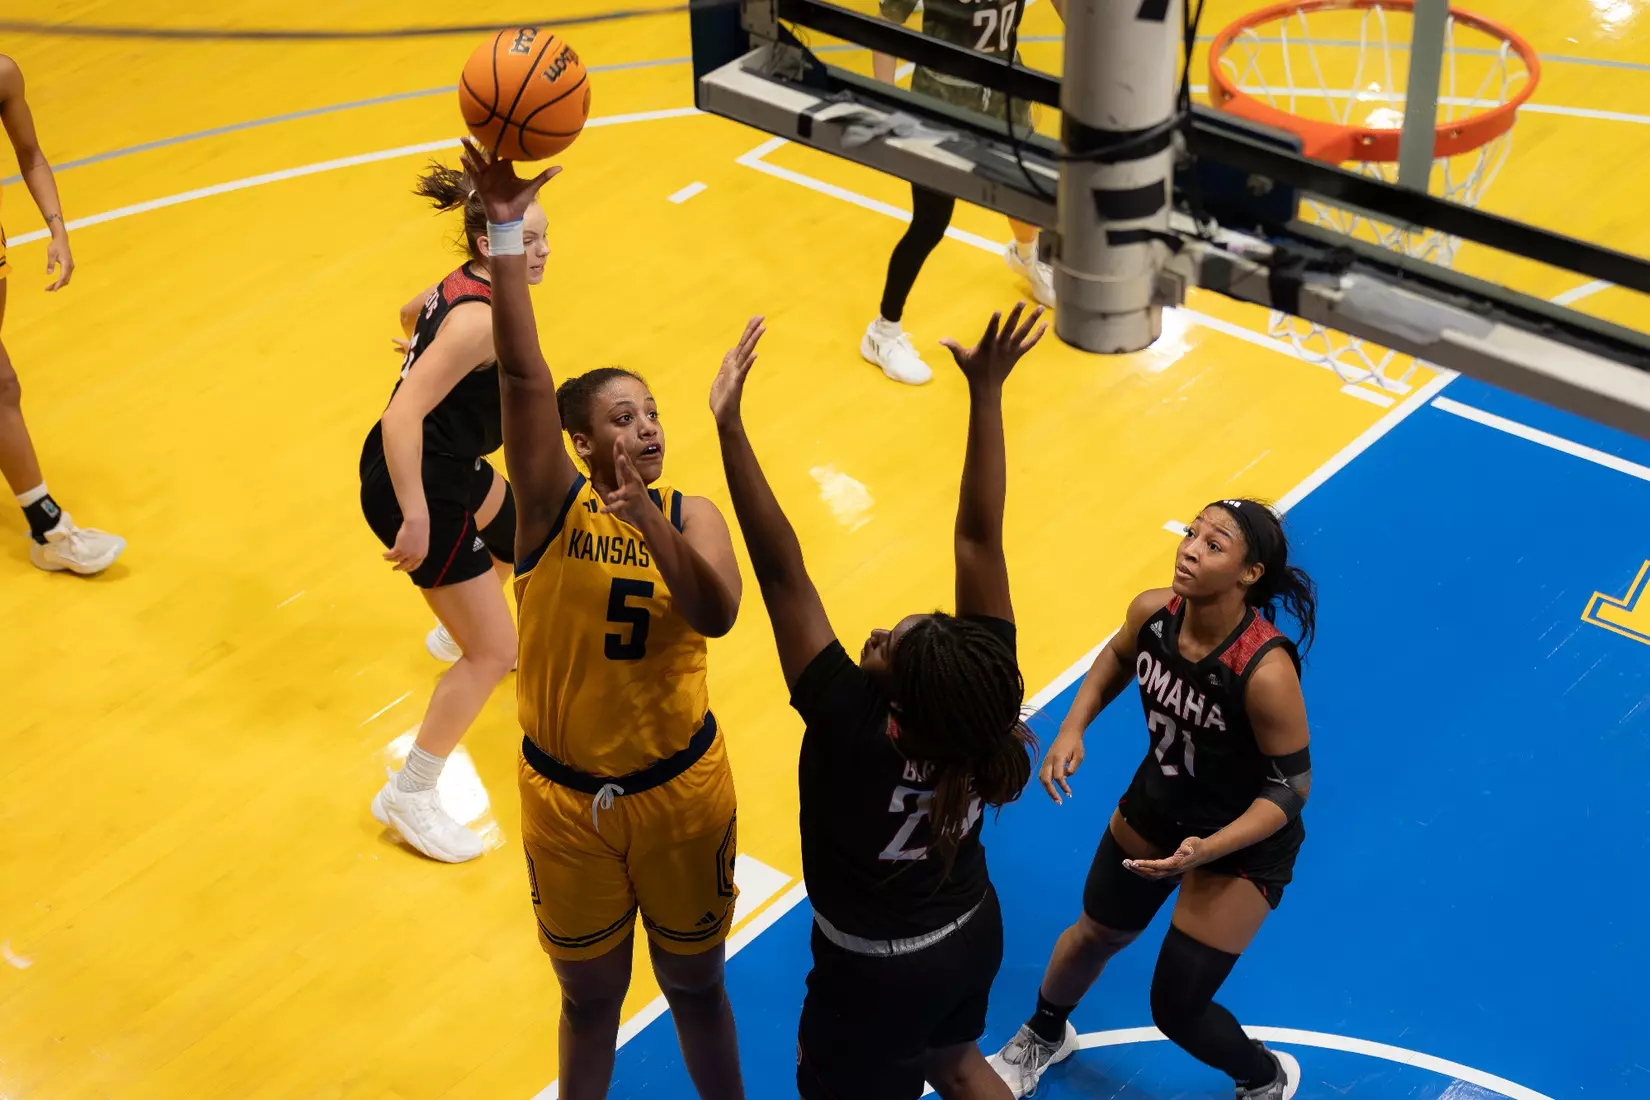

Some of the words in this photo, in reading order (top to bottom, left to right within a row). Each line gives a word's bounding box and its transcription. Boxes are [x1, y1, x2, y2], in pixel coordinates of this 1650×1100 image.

[509, 28, 538, 56] CAA
[973, 1, 1017, 53] 20
[567, 528, 650, 568] KANSAS
[604, 577, 654, 660] 5
[1136, 651, 1227, 732] OMAHA
[1148, 709, 1196, 778] 21
